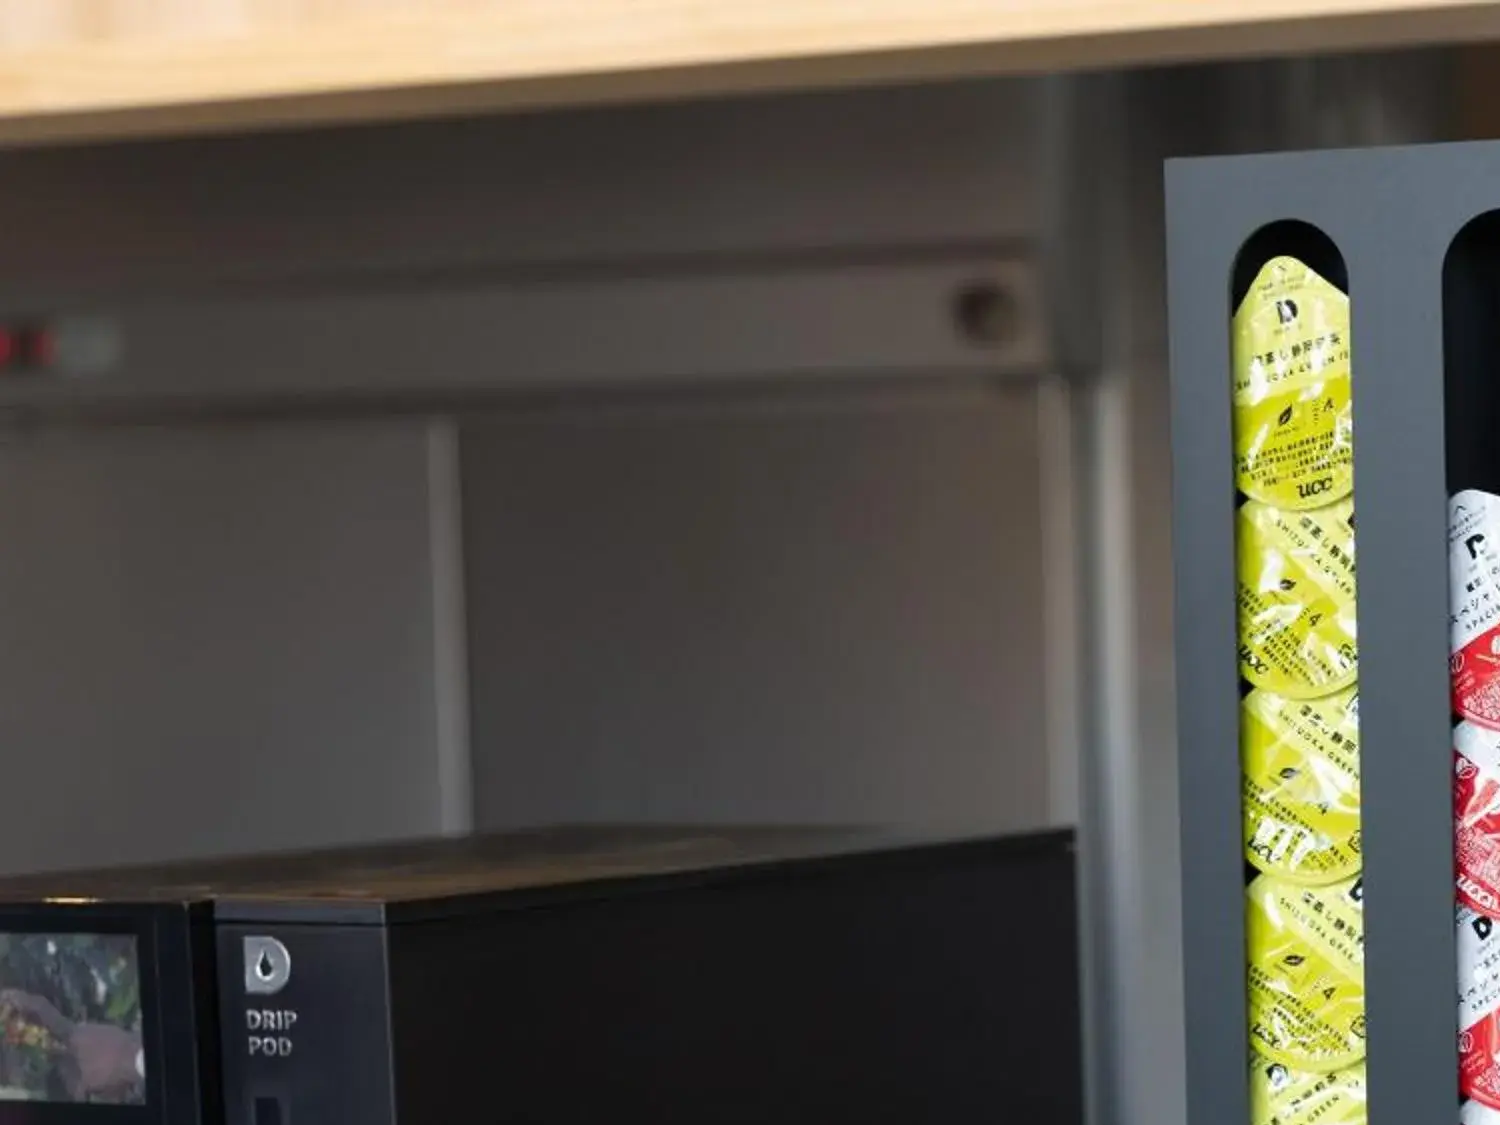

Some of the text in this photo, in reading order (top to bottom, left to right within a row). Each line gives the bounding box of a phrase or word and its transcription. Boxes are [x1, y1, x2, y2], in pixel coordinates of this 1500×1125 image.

[1297, 476, 1334, 498] UCC
[246, 1009, 298, 1030] DRIP
[248, 1035, 293, 1056] POD
